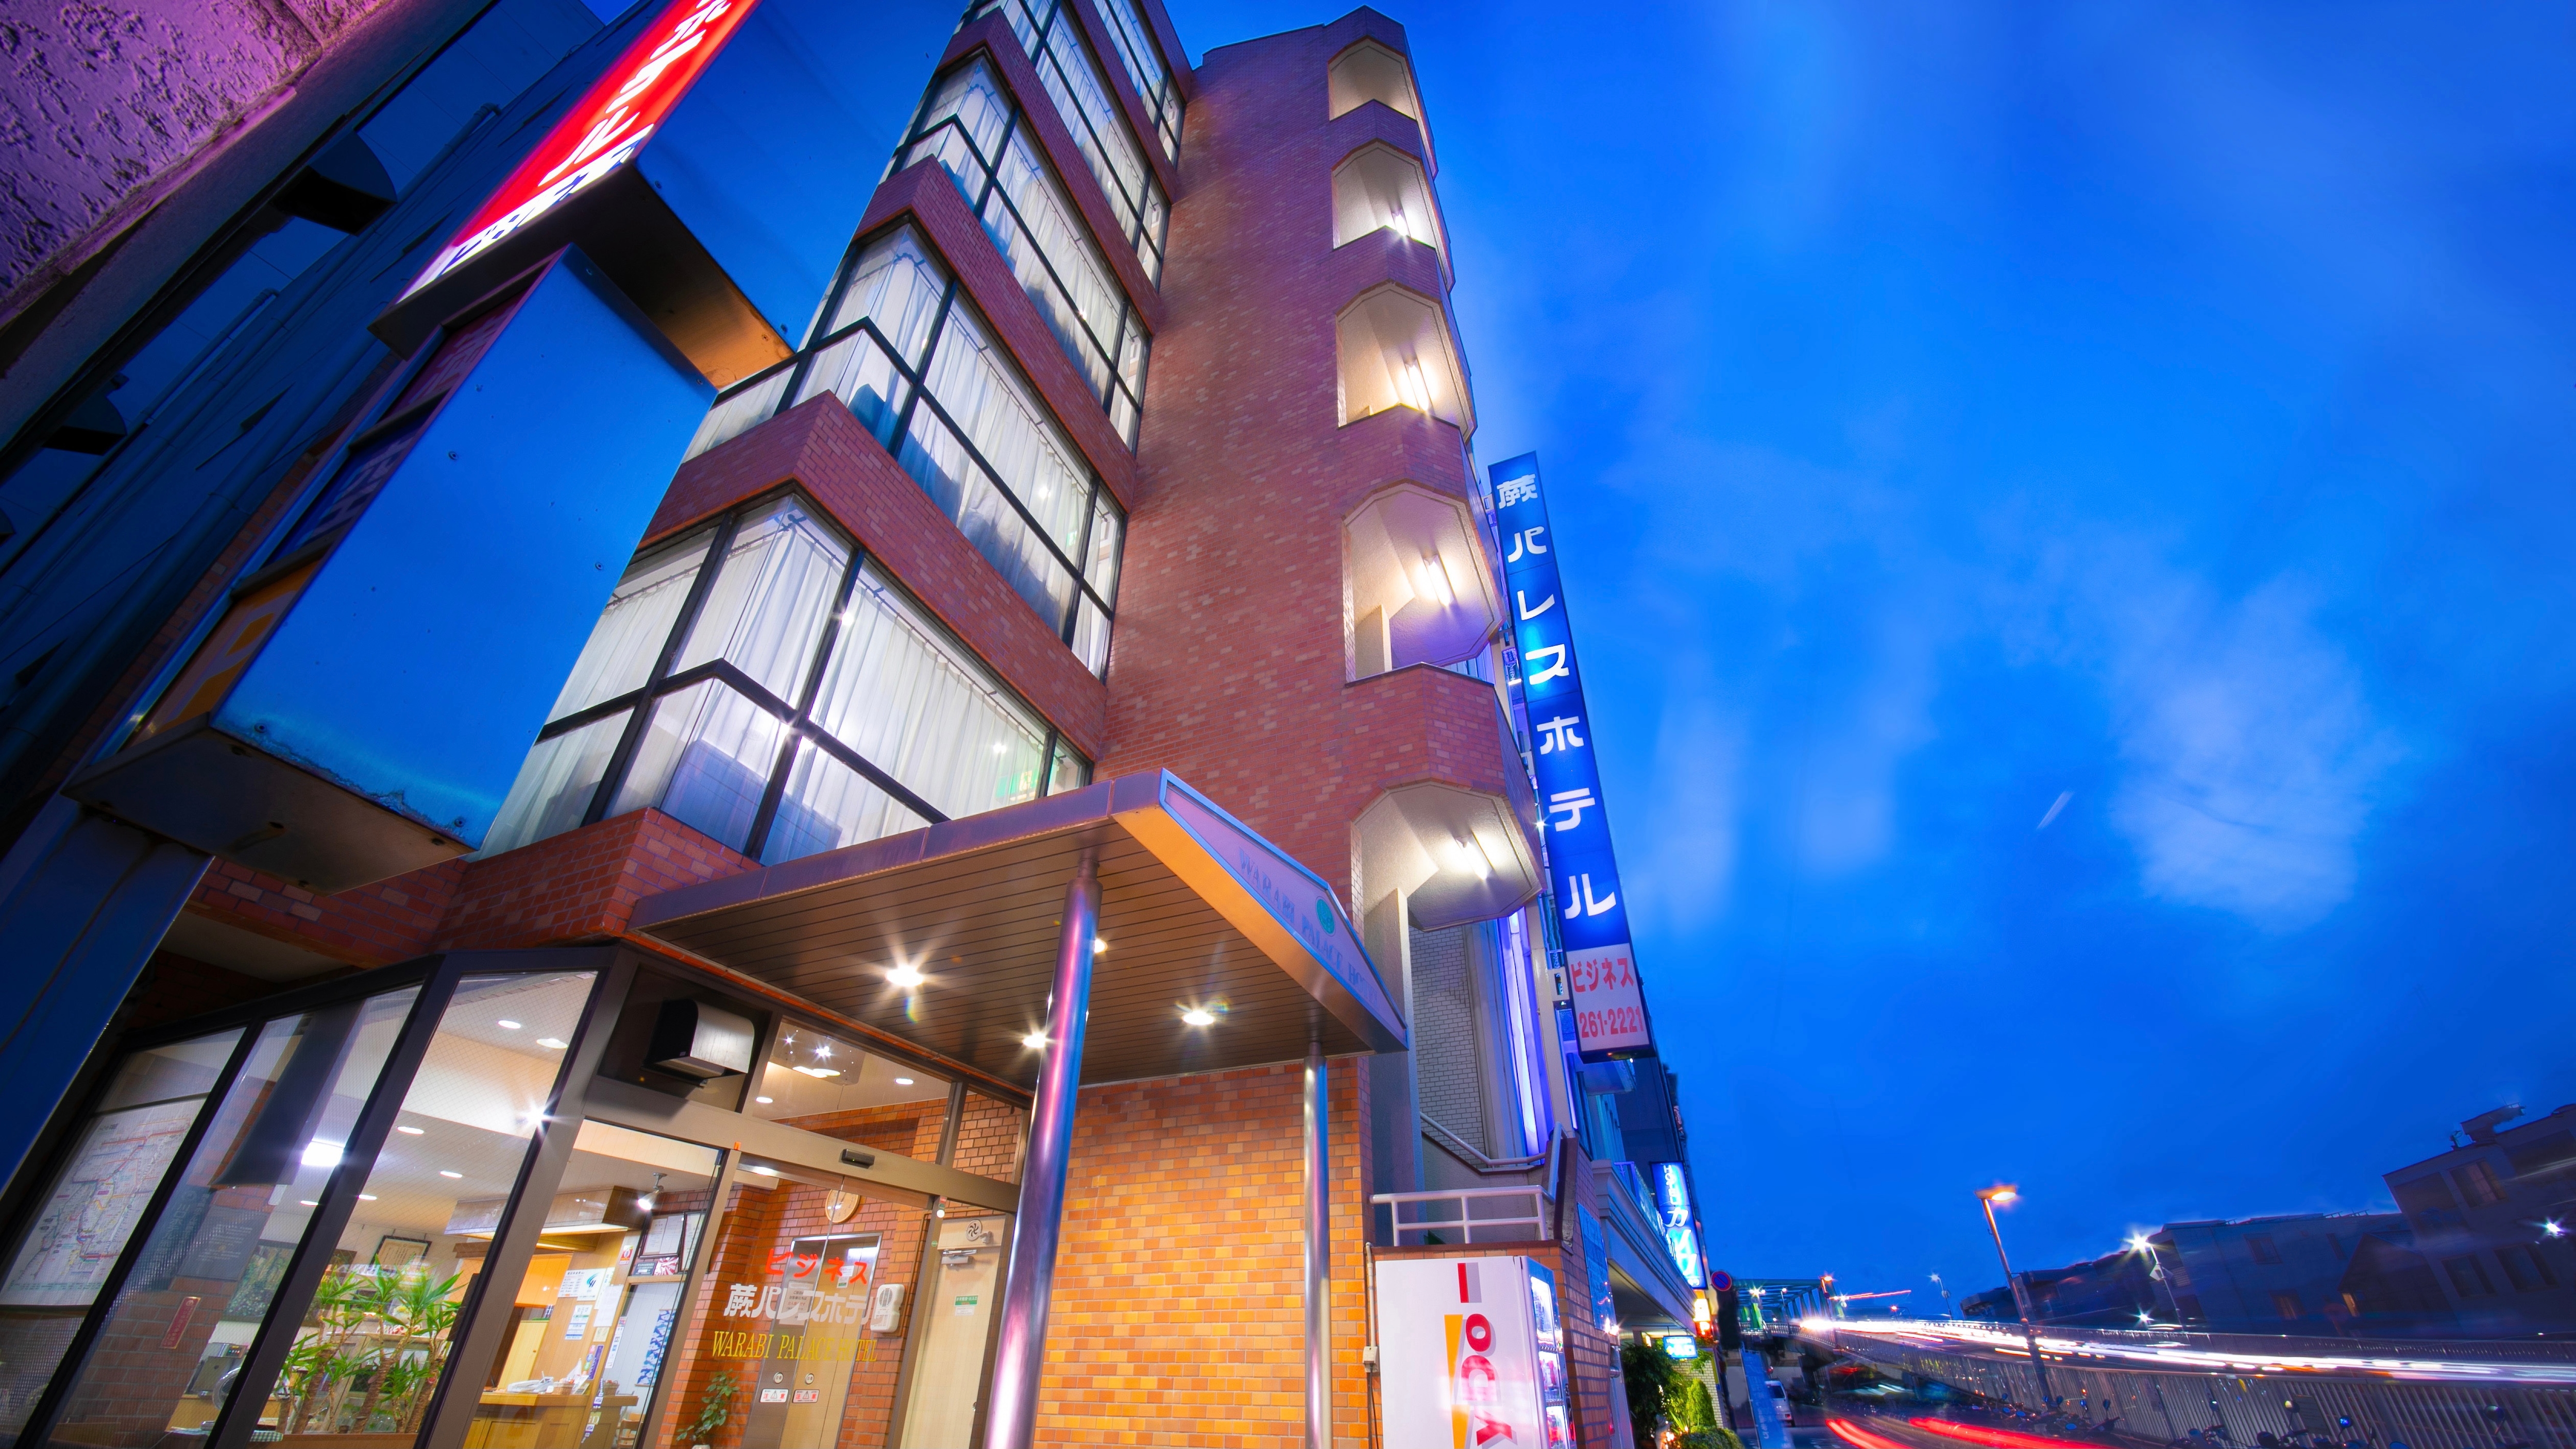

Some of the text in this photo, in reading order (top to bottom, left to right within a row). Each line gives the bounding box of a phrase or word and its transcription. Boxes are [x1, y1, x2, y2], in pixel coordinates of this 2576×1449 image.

[1497, 473, 1617, 919] 蕨パレスホテル
[1570, 957, 1634, 993] ビジネス
[1579, 1005, 1644, 1038] 261-2221
[765, 1249, 868, 1285] ビジネス
[723, 1283, 884, 1326] 蕨パレスホテル
[711, 1330, 878, 1362] WARABI PALACE HOTEL
